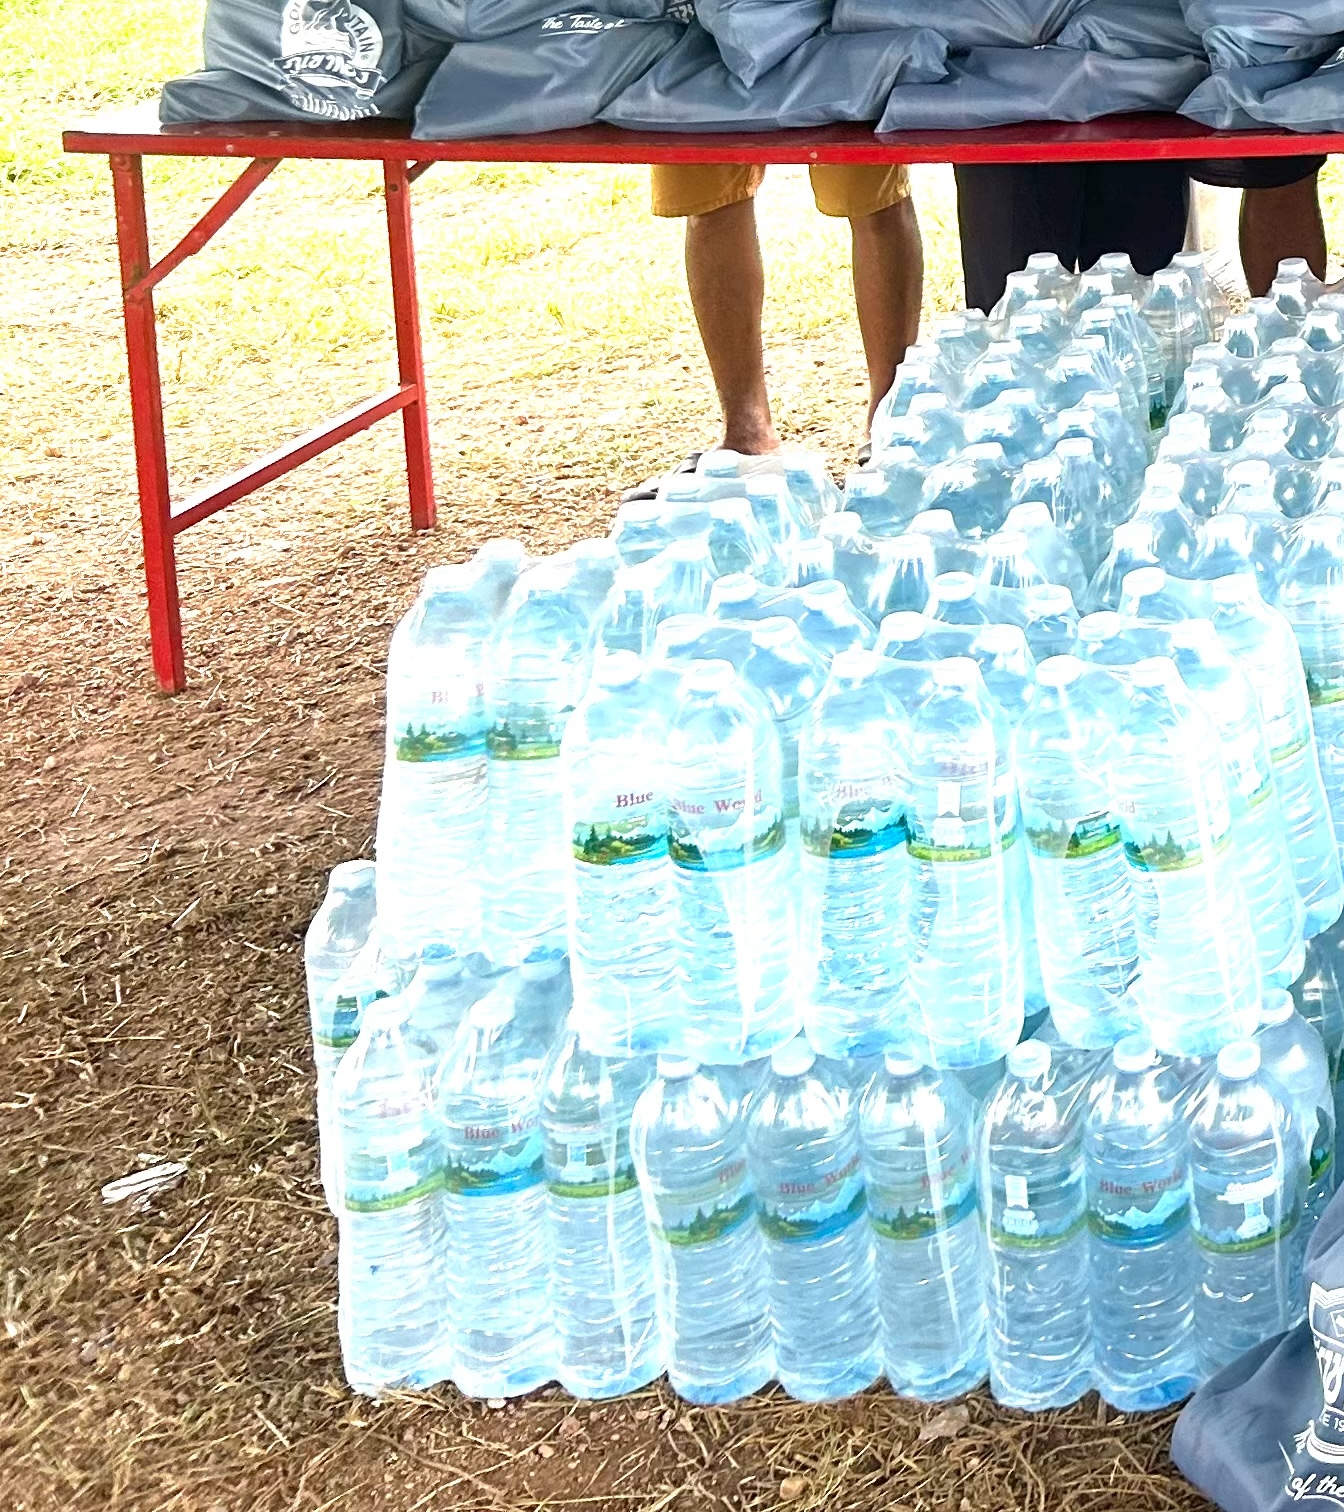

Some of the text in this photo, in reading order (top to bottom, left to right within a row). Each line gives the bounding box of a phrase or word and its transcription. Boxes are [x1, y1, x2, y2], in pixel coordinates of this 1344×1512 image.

[542, 17, 563, 30] The
[569, 15, 603, 30] Taste
[615, 790, 654, 809] Blue
[1291, 1473, 1317, 1501] of
